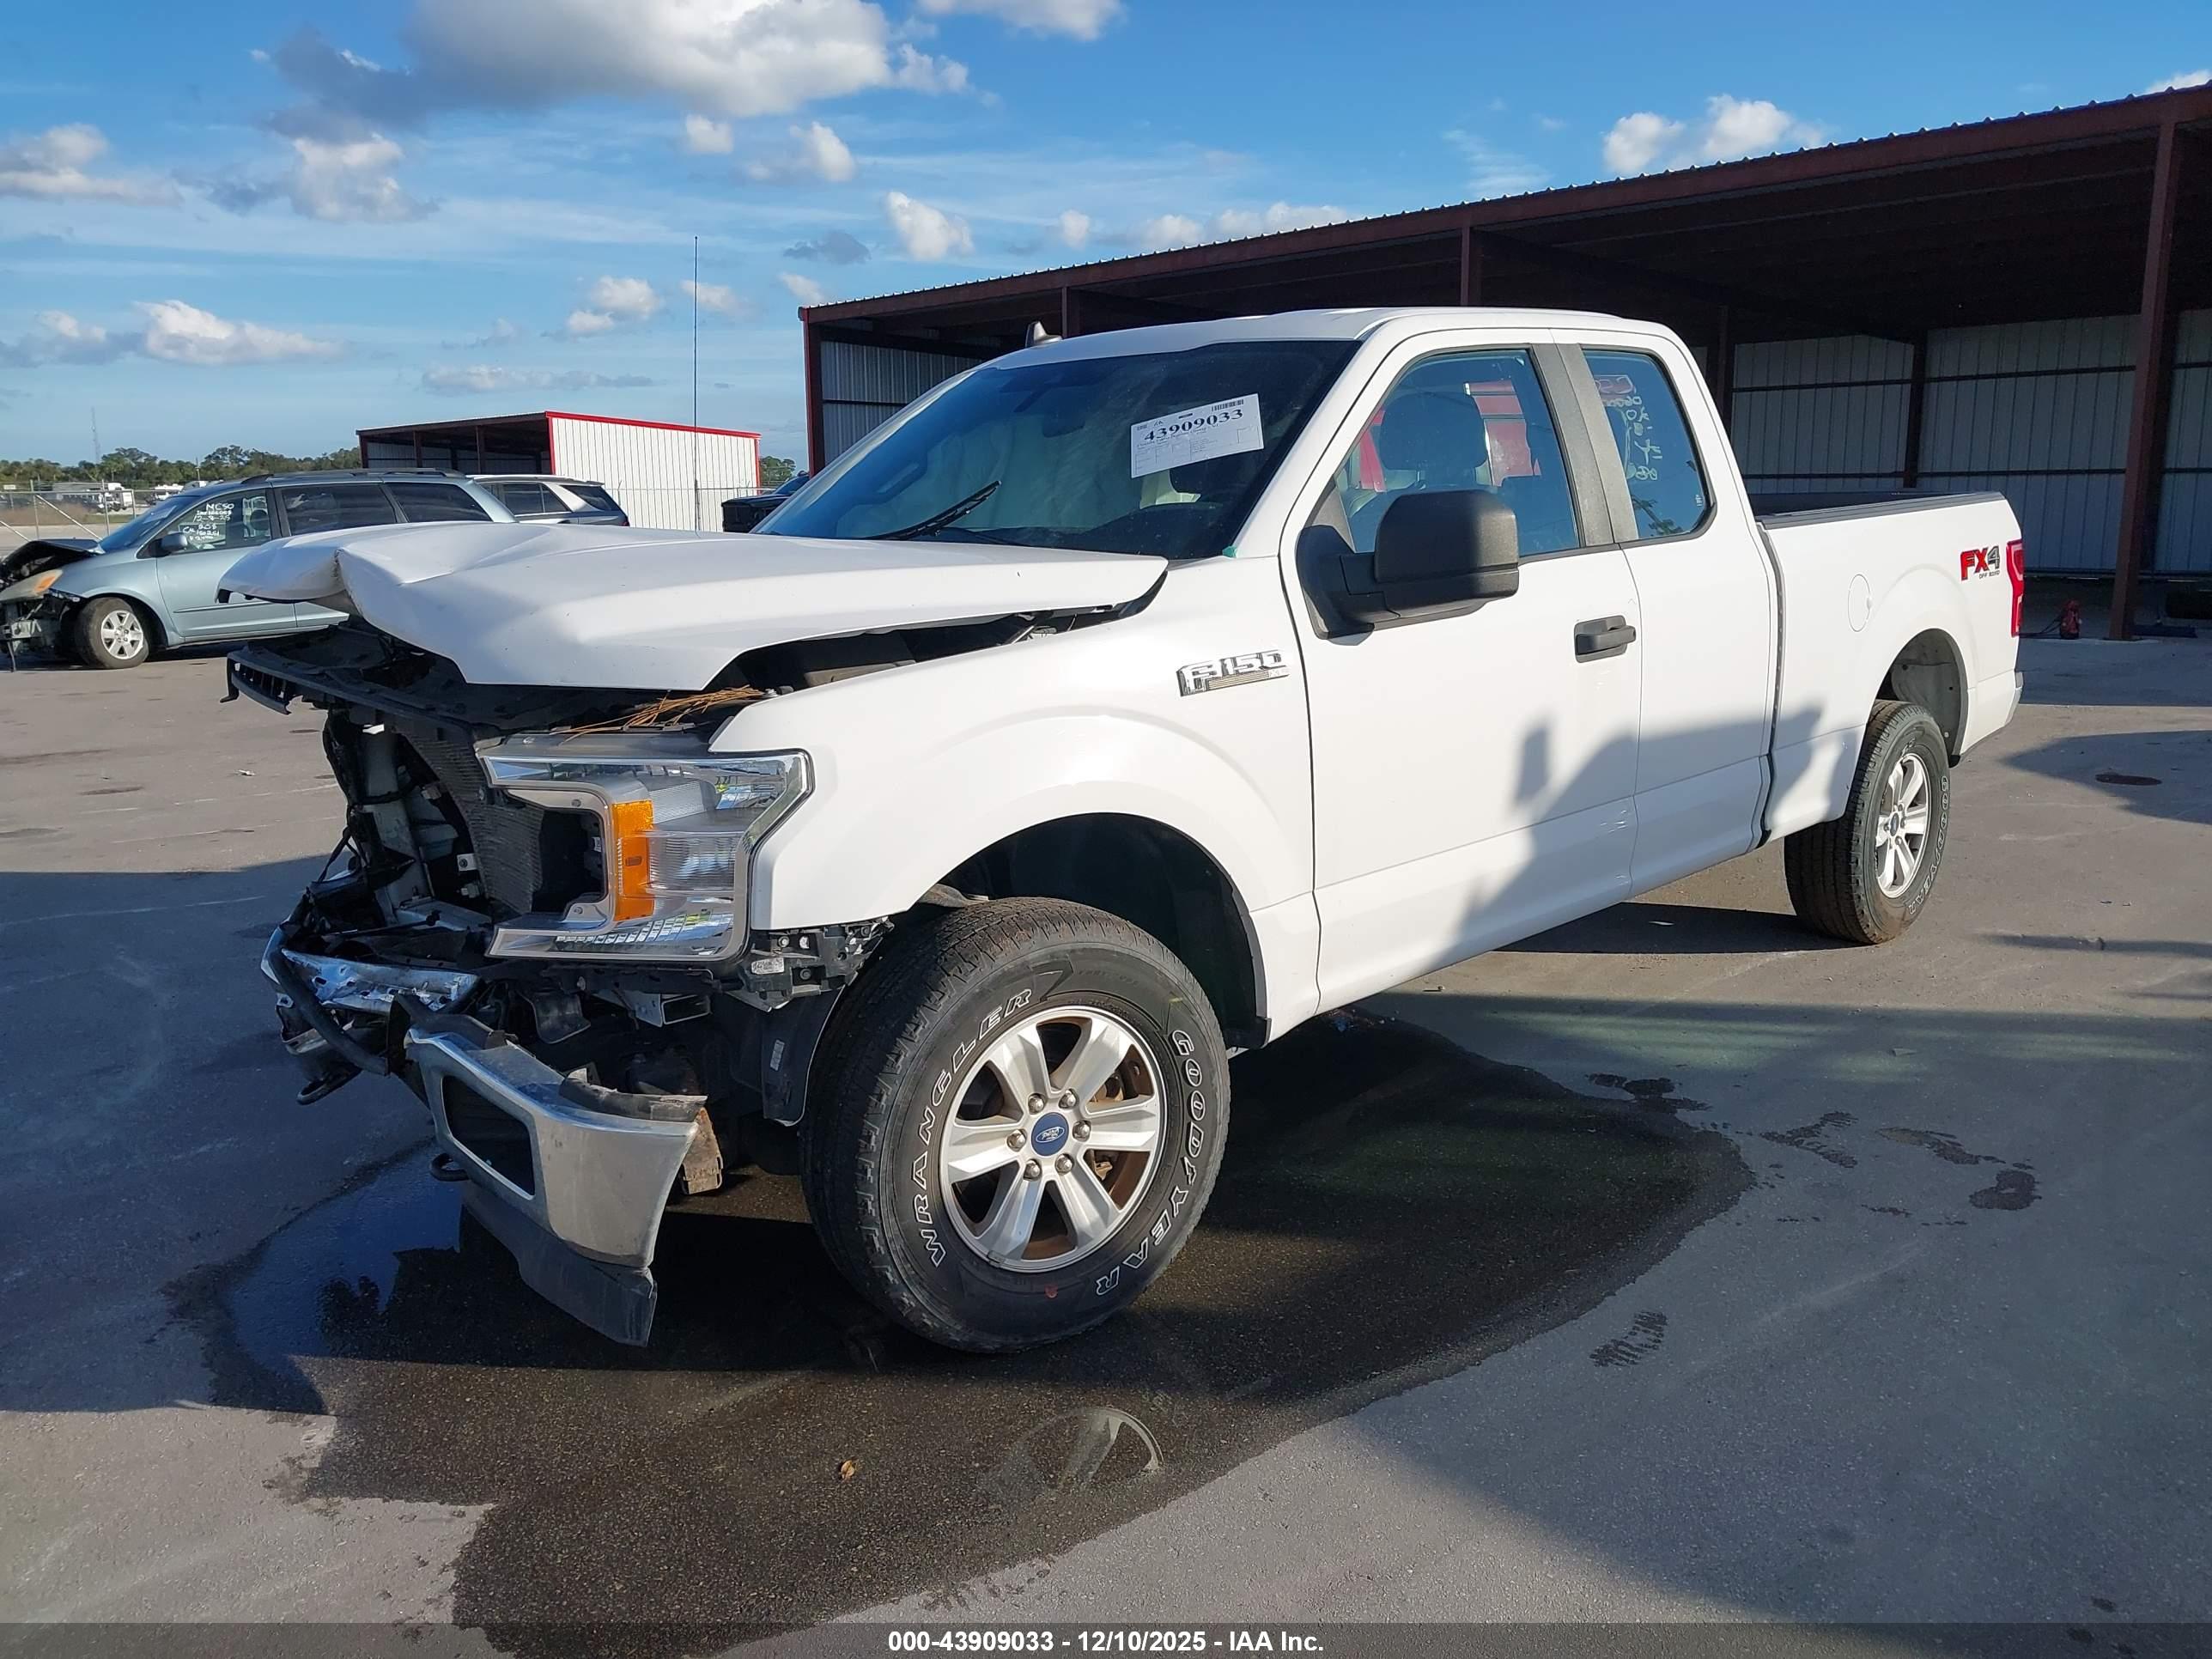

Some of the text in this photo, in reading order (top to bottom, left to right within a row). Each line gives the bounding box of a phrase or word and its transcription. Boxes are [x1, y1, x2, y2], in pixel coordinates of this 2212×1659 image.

[1144, 408, 1243, 441] 43909033
[1960, 545, 2001, 581] FX4
[912, 988, 1033, 1267] WRANGLER
[1096, 1030, 1206, 1297] GOODYEAR
